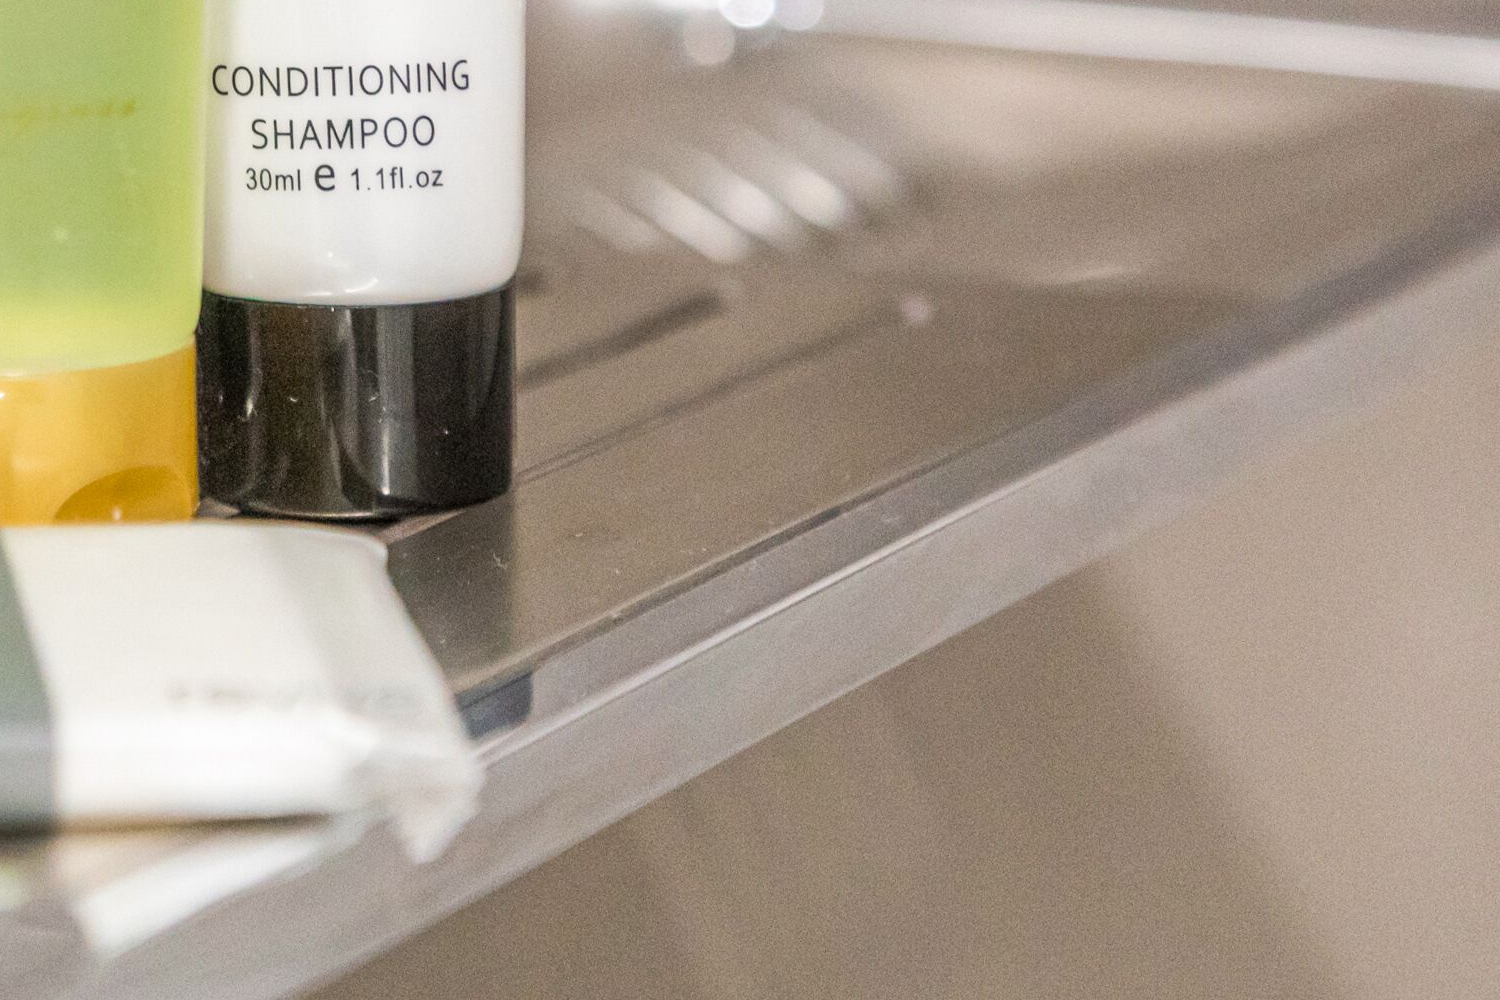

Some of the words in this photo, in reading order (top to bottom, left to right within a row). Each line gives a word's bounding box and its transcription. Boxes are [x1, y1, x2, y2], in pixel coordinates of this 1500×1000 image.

[211, 59, 471, 97] CONDITIONING
[251, 115, 436, 150] SHAMPOO
[245, 168, 302, 192] 30ml
